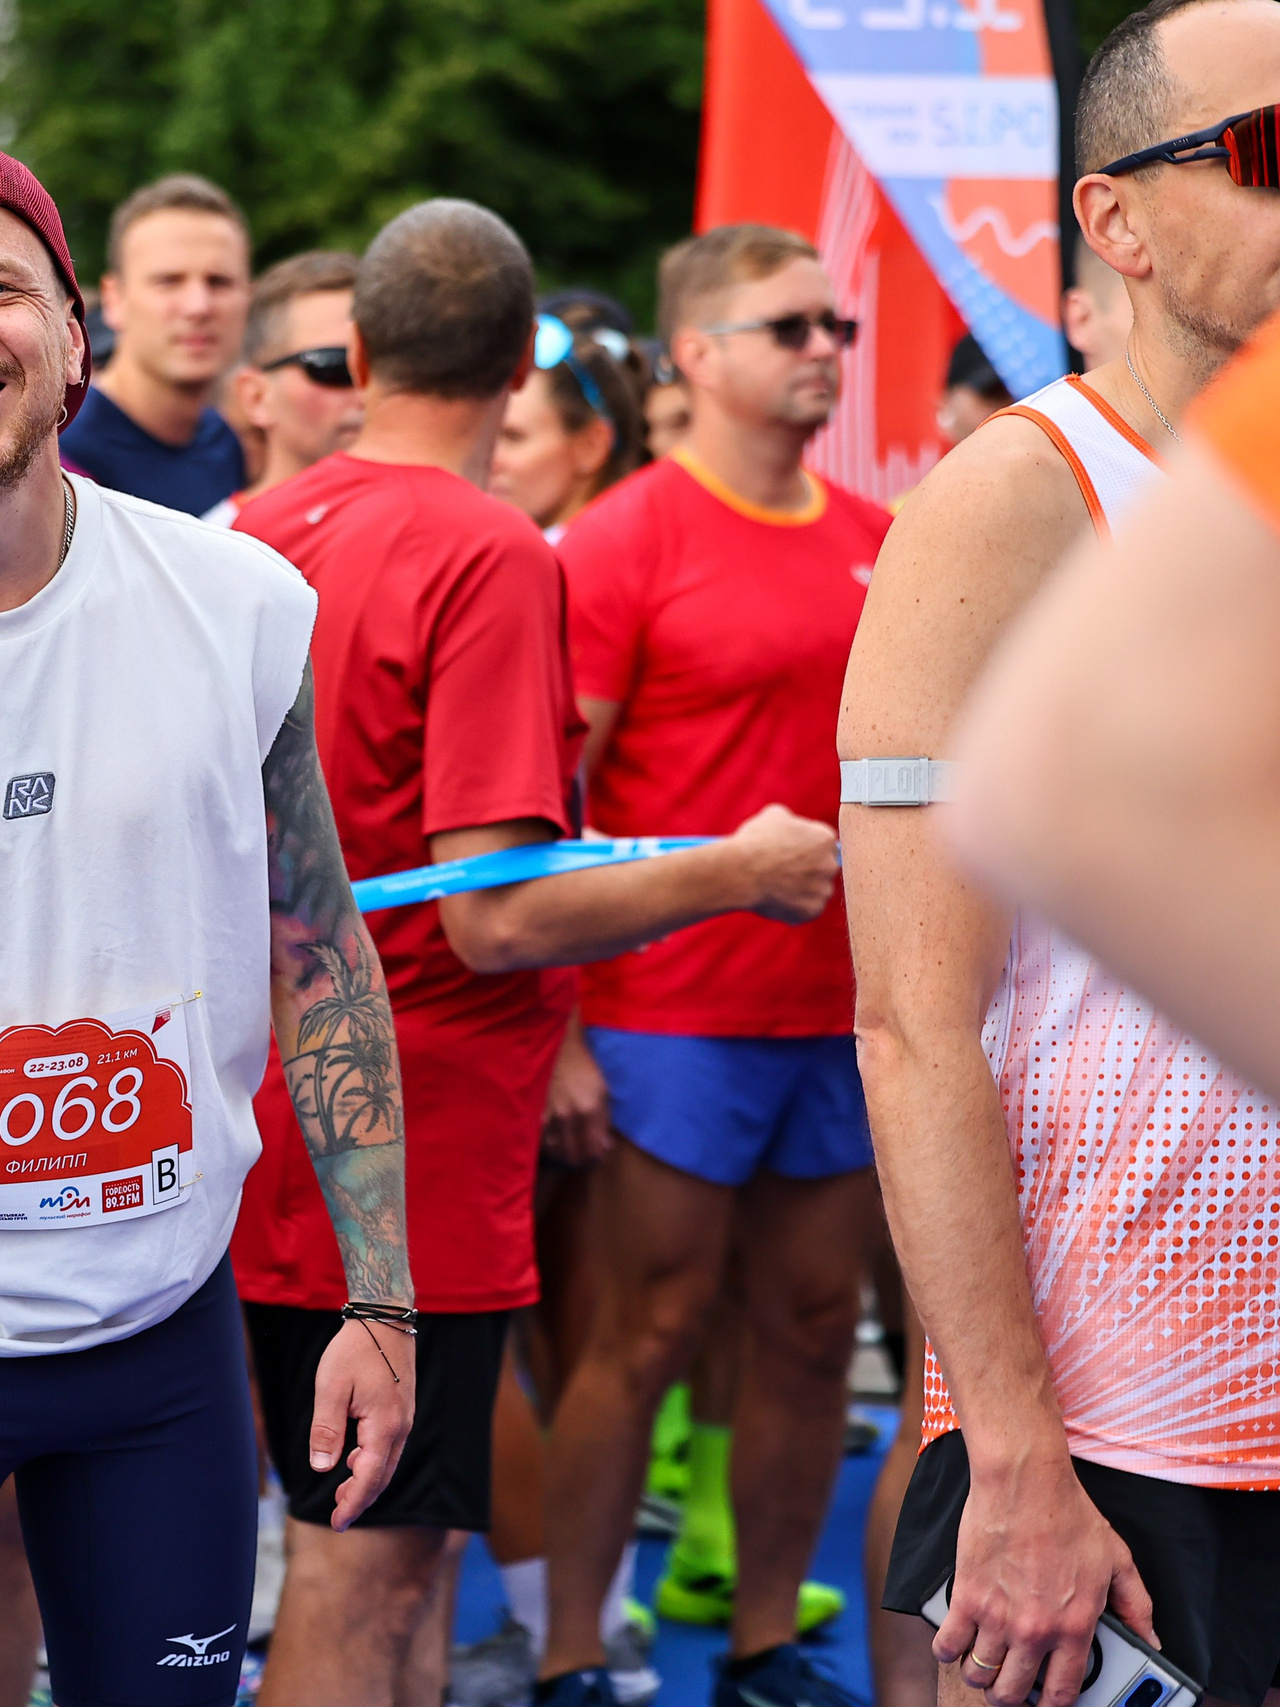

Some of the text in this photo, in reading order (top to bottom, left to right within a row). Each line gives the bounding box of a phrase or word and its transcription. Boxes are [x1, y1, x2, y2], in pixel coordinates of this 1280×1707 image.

[27, 1056, 85, 1074] 22-23.08
[96, 1052, 120, 1066] 21,1
[4, 1152, 88, 1175] ФИЛИПП
[105, 1191, 140, 1209] 89.2 FM
[155, 1650, 231, 1668] MIZUNO
